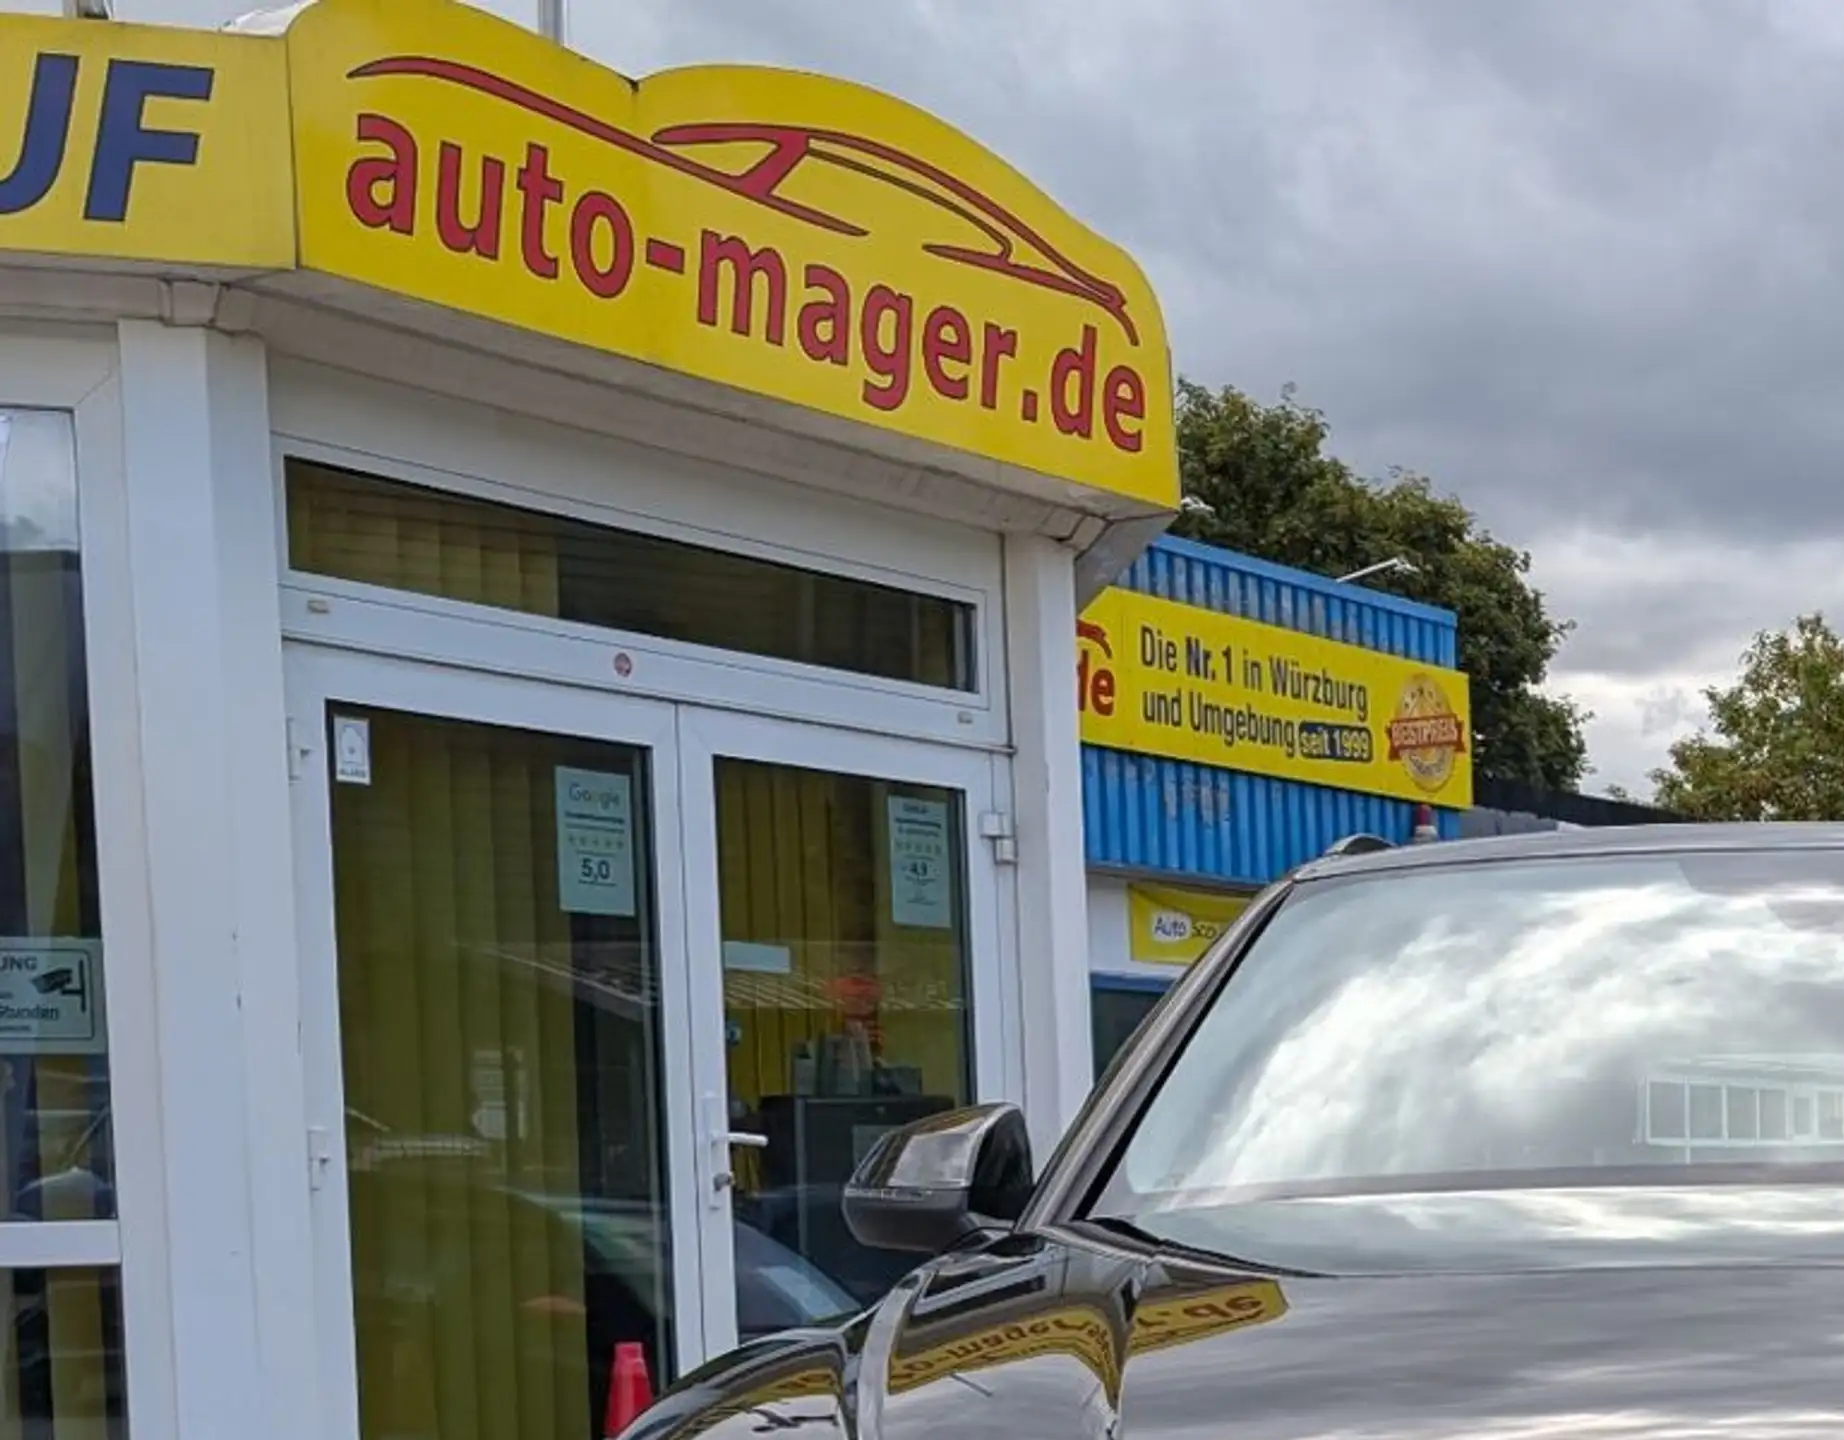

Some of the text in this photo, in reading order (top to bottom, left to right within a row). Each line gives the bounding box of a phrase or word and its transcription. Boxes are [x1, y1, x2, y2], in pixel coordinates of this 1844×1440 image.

[346, 113, 1145, 452] auto-mager.de
[1141, 626, 1367, 722] Die Nr. 1 in Würzburg
[1142, 688, 1182, 727] und
[1189, 690, 1295, 758] Umgebung
[1301, 728, 1330, 758] seit
